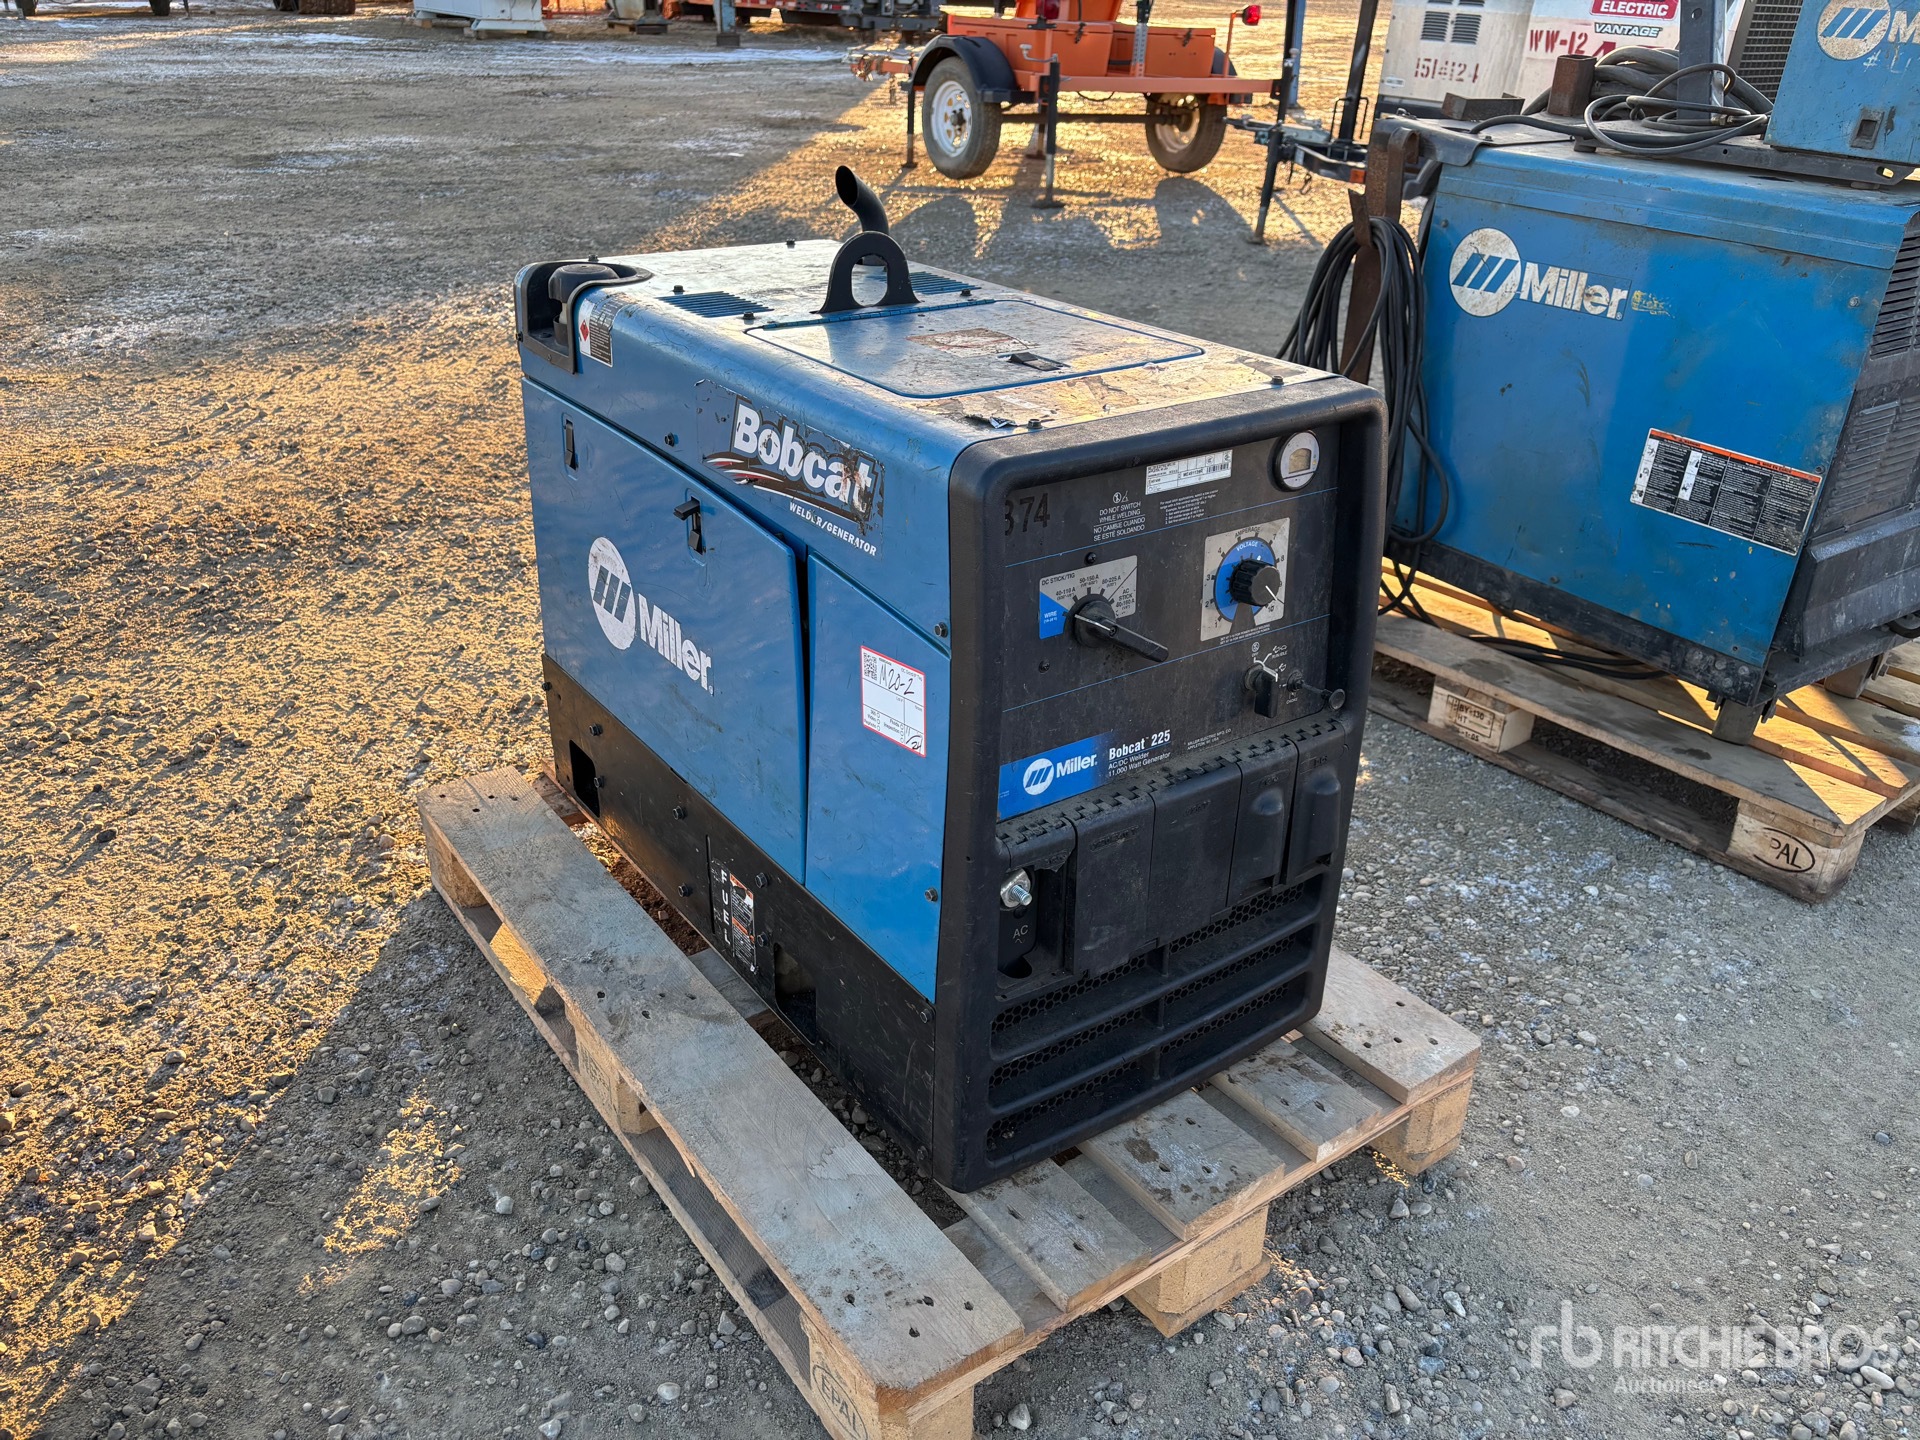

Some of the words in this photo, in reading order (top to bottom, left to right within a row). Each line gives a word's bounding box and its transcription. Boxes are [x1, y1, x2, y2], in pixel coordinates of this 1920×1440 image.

[1600, 0, 1669, 16] ELECTRIC
[1595, 22, 1660, 37] VANTAGE
[1529, 29, 1588, 55] WW-12
[1520, 261, 1629, 319] Miller
[733, 402, 874, 513] Bobcat
[1121, 501, 1141, 511] SWITCH
[1117, 509, 1140, 519] WELDING
[1094, 526, 1101, 534] NO
[1117, 525, 1145, 537] SOLDANDO
[1234, 527, 1260, 538] AMPERAGE
[1236, 541, 1258, 551] VOLTAGE
[1050, 572, 1075, 584] STICK/TIG
[1043, 610, 1058, 619] WIRE
[638, 593, 712, 691] Miller
[1457, 714, 1468, 724] HT
[1109, 738, 1146, 760] Bobcat
[1151, 729, 1171, 746] 225
[1056, 754, 1097, 778] Miller
[1108, 758, 1129, 770] AC/DC
[1129, 752, 1150, 763] Welder
[1129, 761, 1142, 770] Watt
[1142, 752, 1171, 766] Generator
[1013, 924, 1029, 939] AC
[821, 1373, 861, 1439] EPAL
